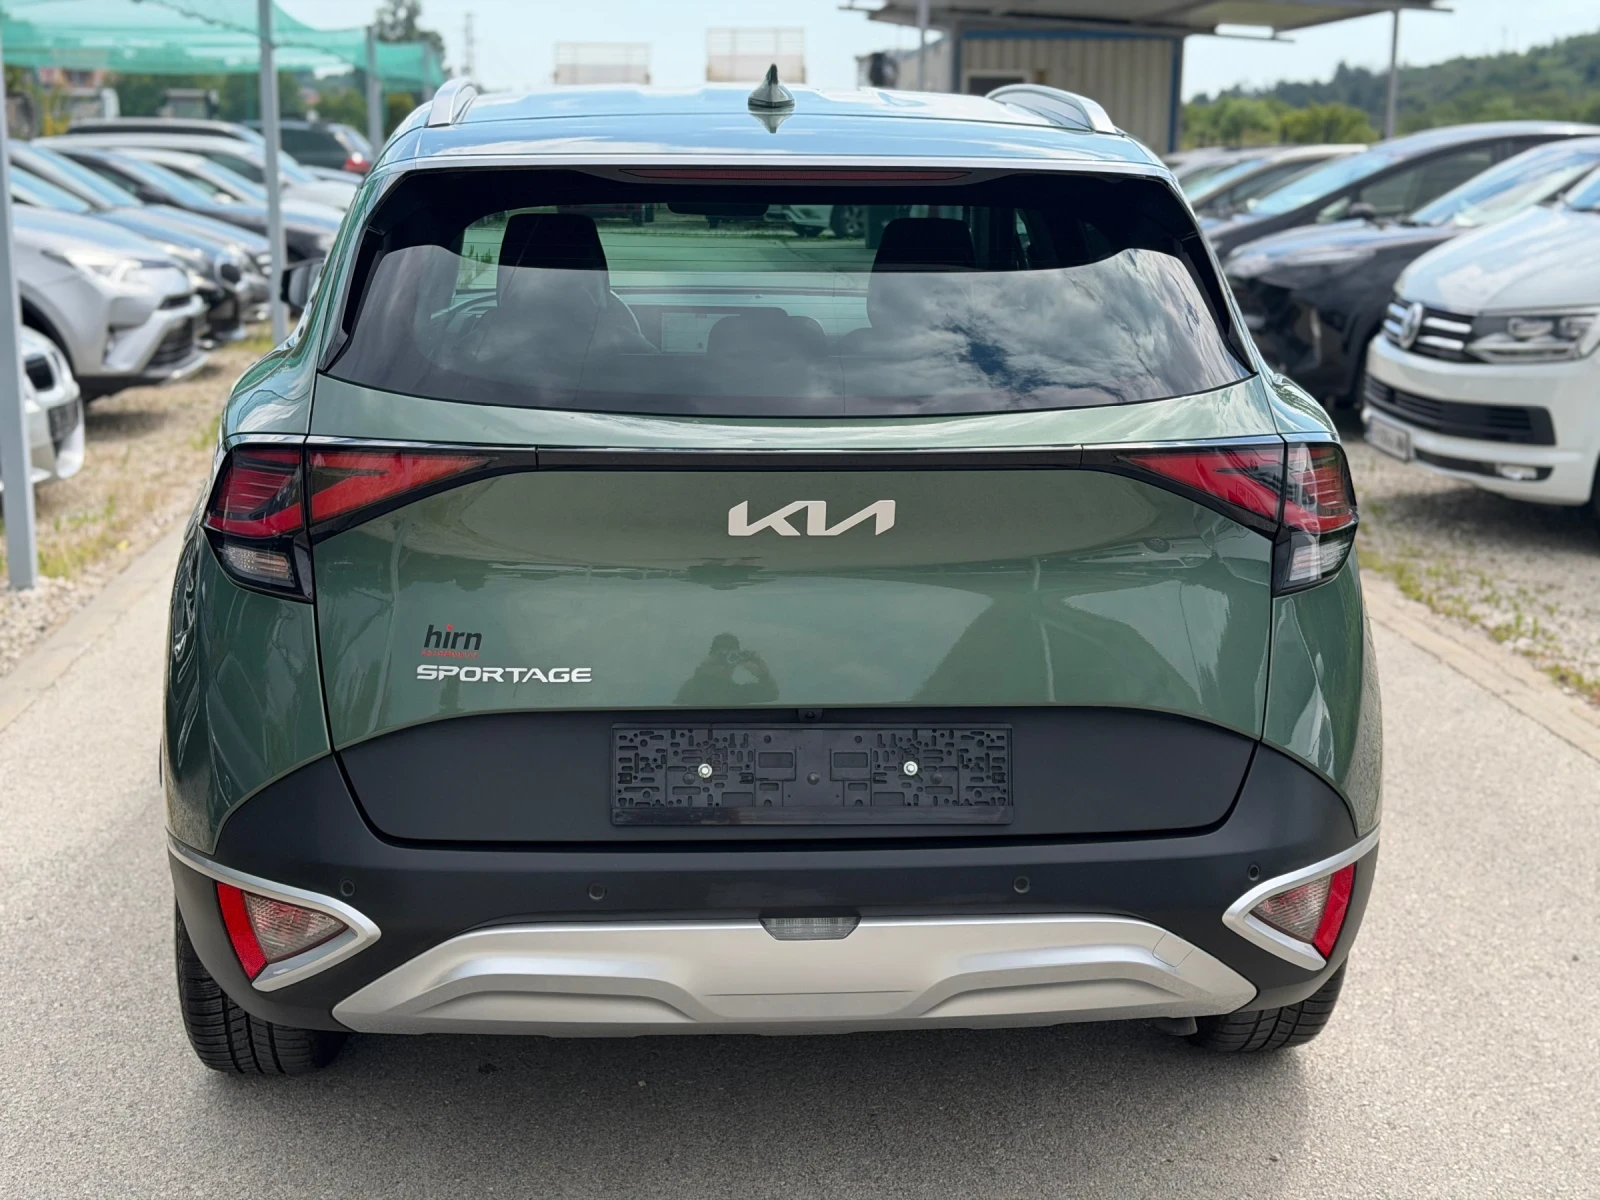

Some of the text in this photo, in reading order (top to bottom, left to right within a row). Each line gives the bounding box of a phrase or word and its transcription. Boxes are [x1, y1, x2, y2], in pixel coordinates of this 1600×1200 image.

[728, 500, 896, 536] KIA
[423, 624, 482, 650] hirn
[416, 664, 592, 684] SPORTAGE
